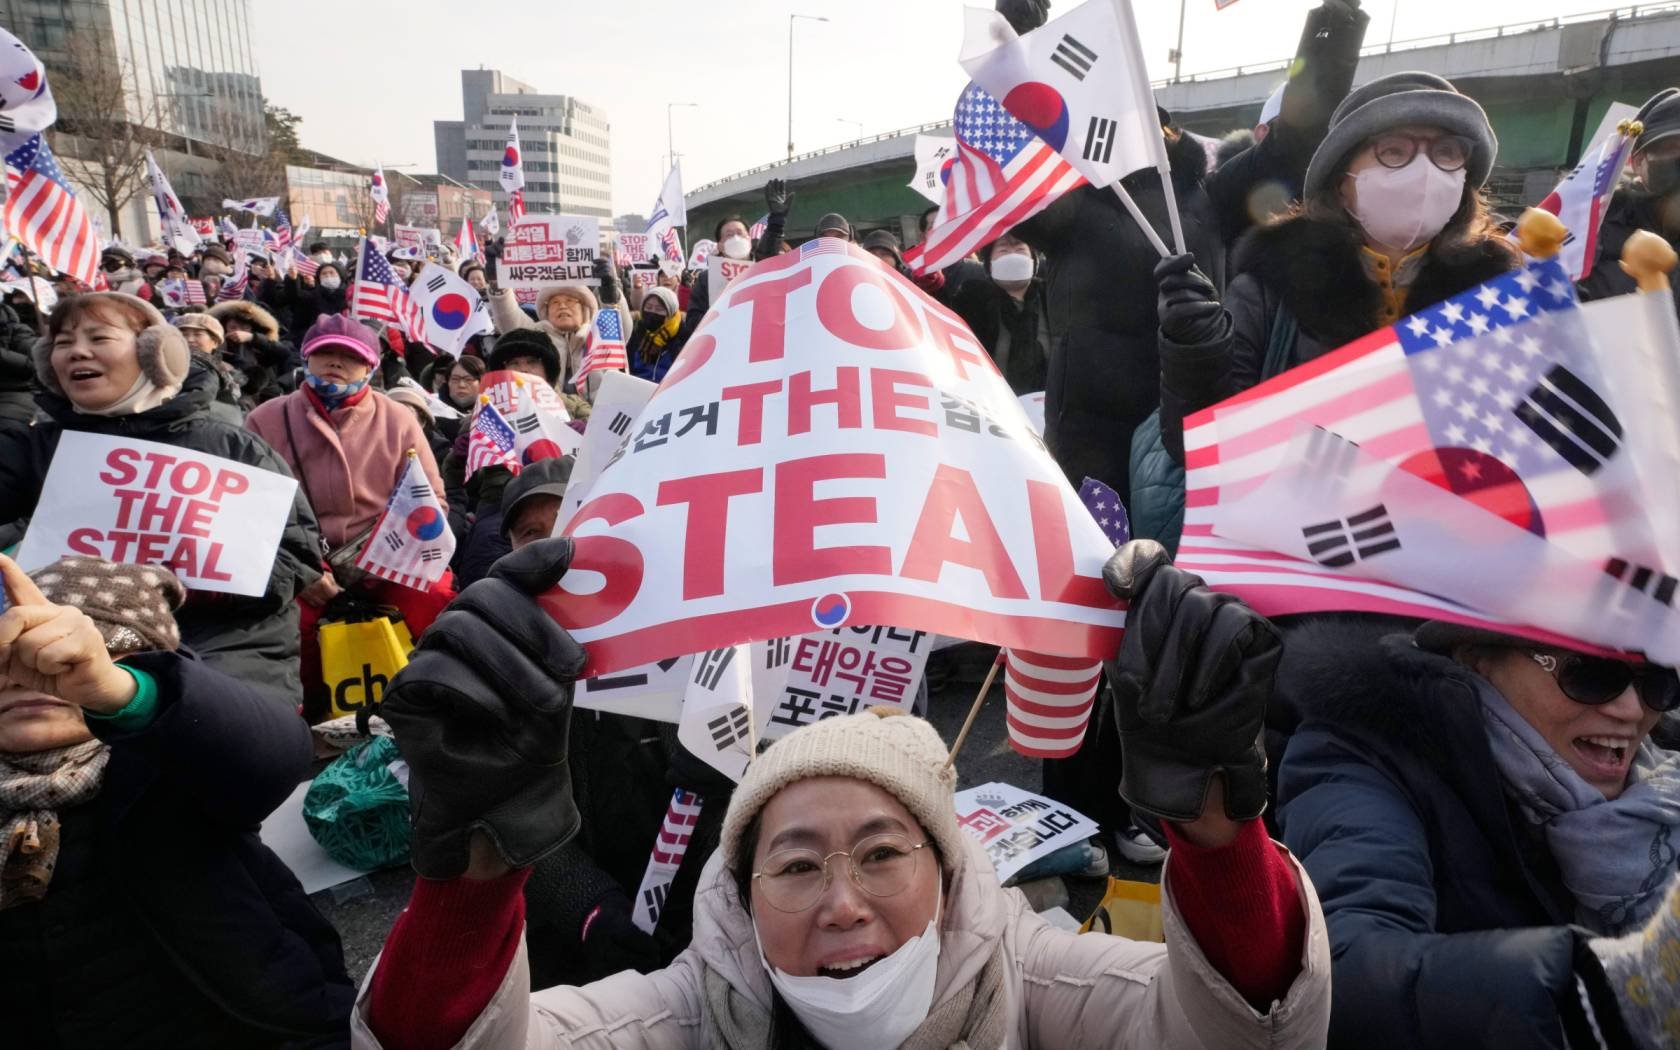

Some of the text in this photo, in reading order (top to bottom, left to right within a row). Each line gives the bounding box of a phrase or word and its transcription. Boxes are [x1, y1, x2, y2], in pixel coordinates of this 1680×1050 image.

[620, 235, 648, 244] STOP
[624, 245, 645, 253] THE
[565, 247, 594, 262] 함께
[509, 265, 598, 281] 싸우겠습니다
[641, 272, 655, 282] ST
[721, 262, 749, 277] ST
[722, 366, 938, 446] THE
[99, 448, 249, 503] STOP
[113, 489, 219, 538] THE
[537, 453, 1129, 629] STEAL
[61, 528, 232, 582] STEAL
[791, 637, 912, 703] 태악을
[999, 799, 1051, 818] 함께
